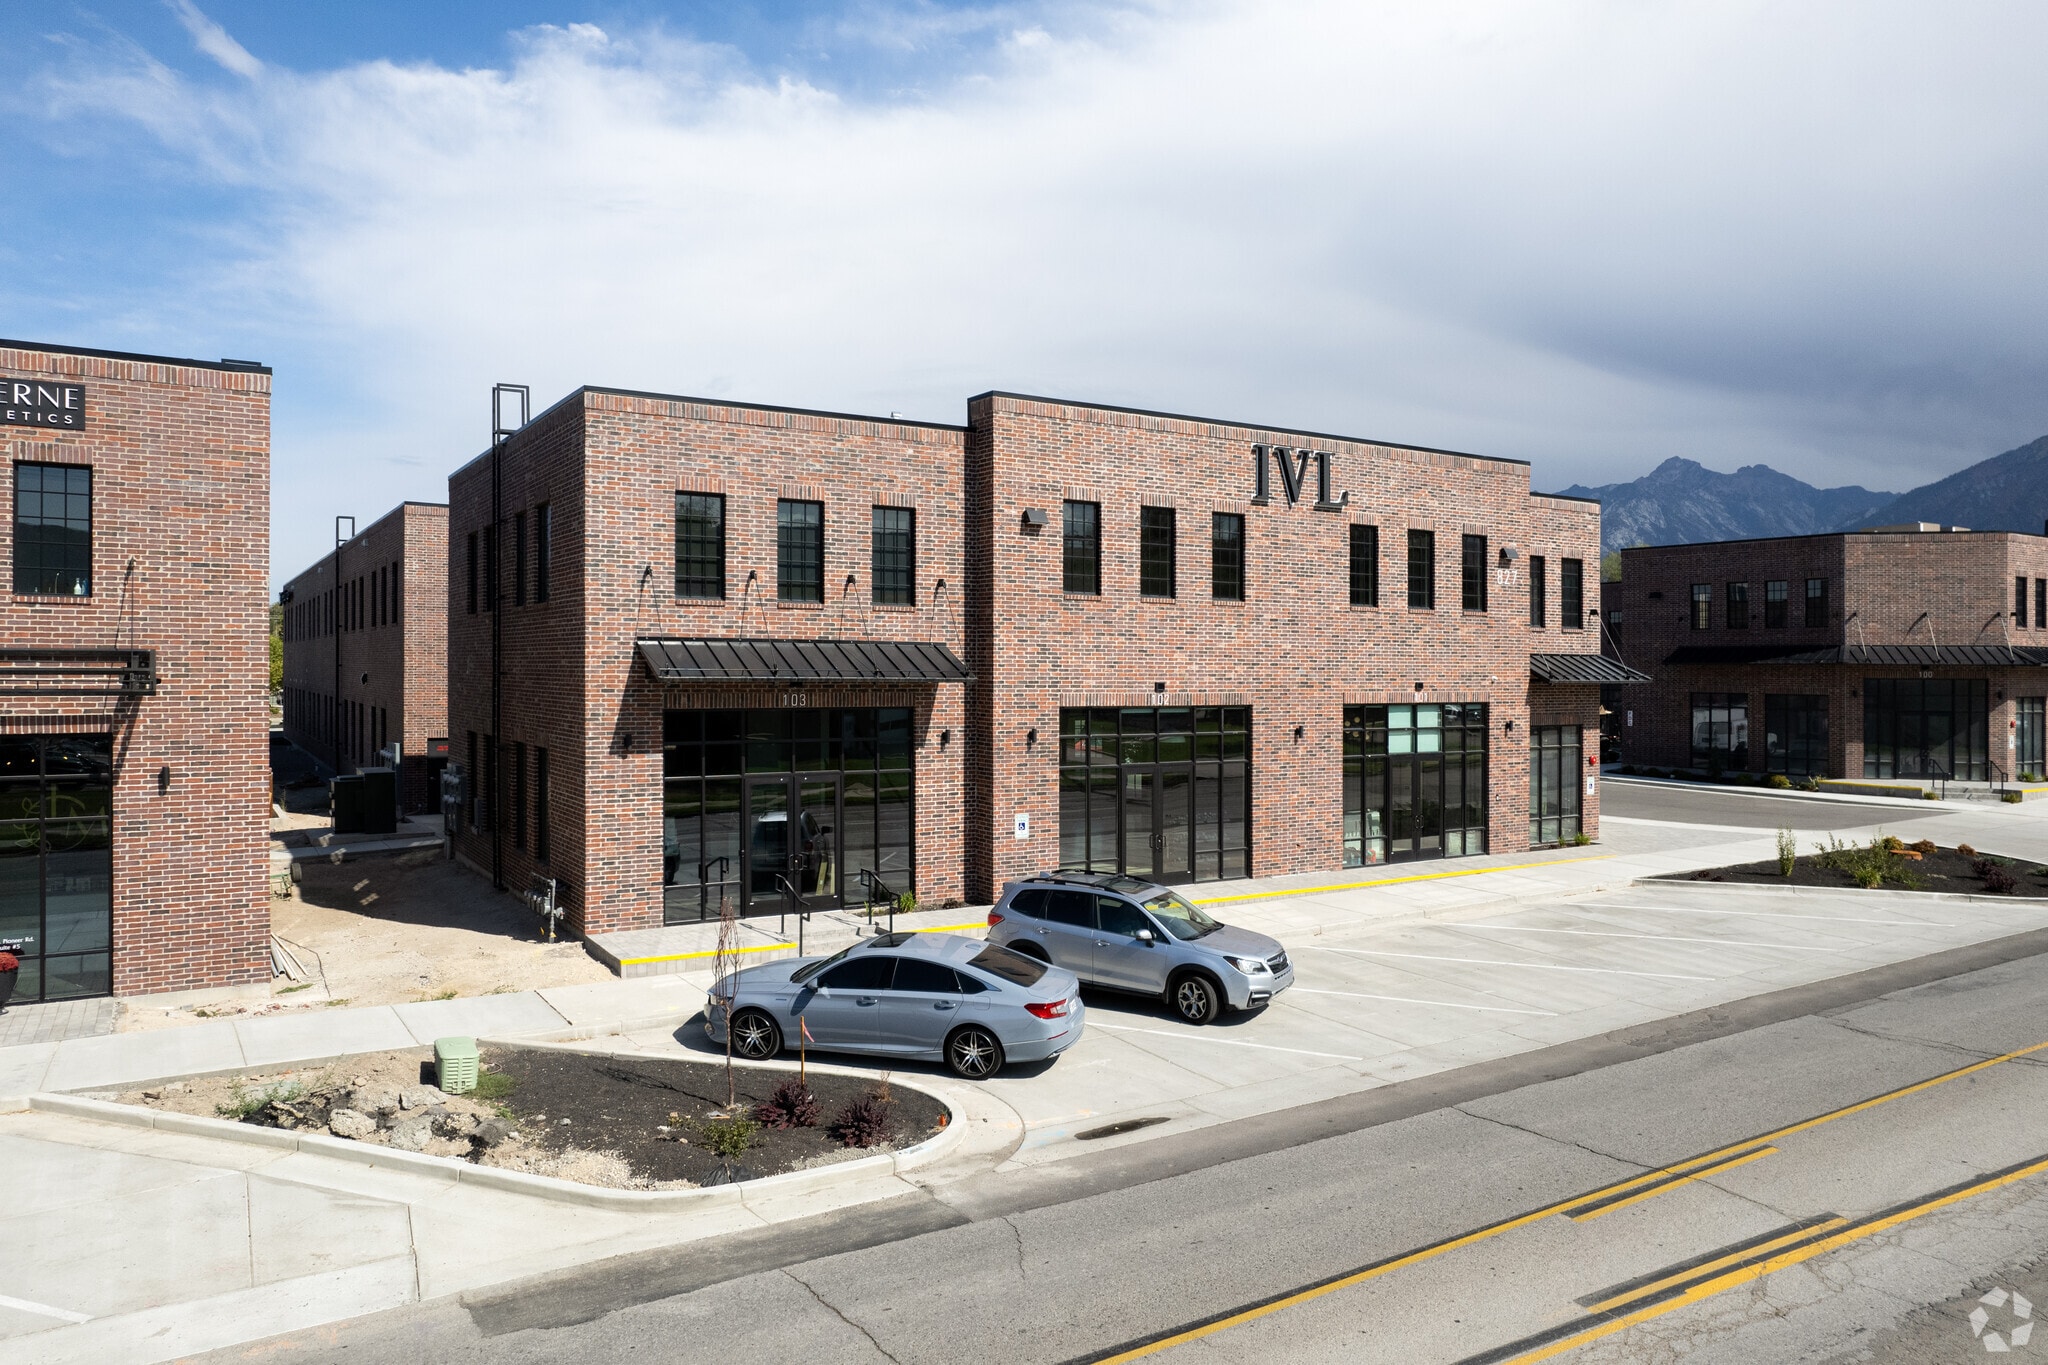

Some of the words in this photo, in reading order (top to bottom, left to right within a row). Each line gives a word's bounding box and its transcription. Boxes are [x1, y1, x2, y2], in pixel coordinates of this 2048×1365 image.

[0, 382, 79, 410] ERNE
[6, 410, 73, 425] ETICS
[1251, 443, 1349, 513] IVL
[1497, 569, 1518, 585] 827
[783, 693, 806, 706] 103
[1151, 694, 1170, 706] 102
